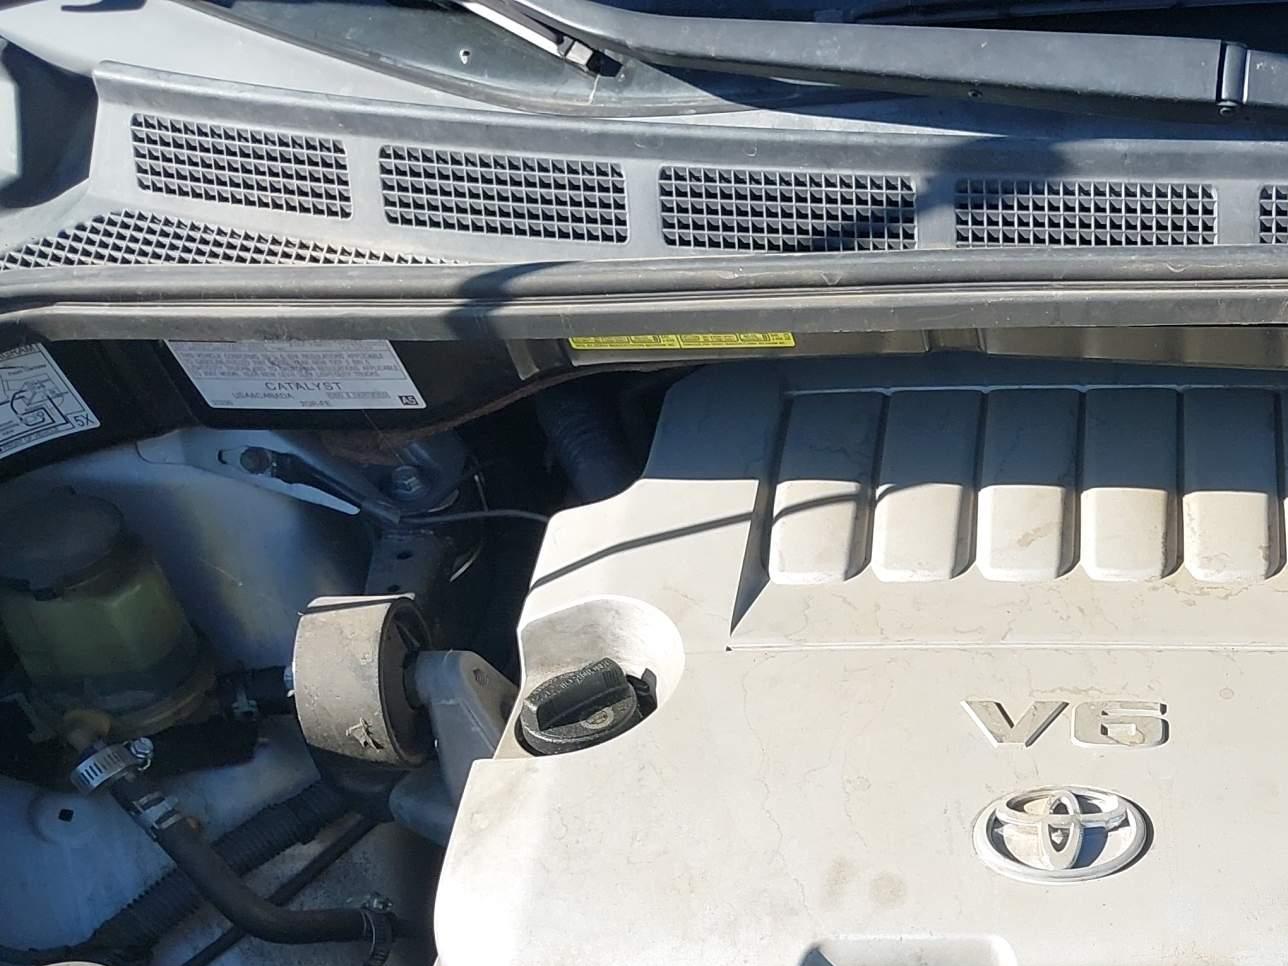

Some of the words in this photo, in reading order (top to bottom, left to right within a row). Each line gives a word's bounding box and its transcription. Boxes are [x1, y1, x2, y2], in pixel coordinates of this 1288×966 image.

[264, 382, 342, 391] CATALYST
[73, 413, 95, 427] 5X
[960, 699, 1170, 749] V6
